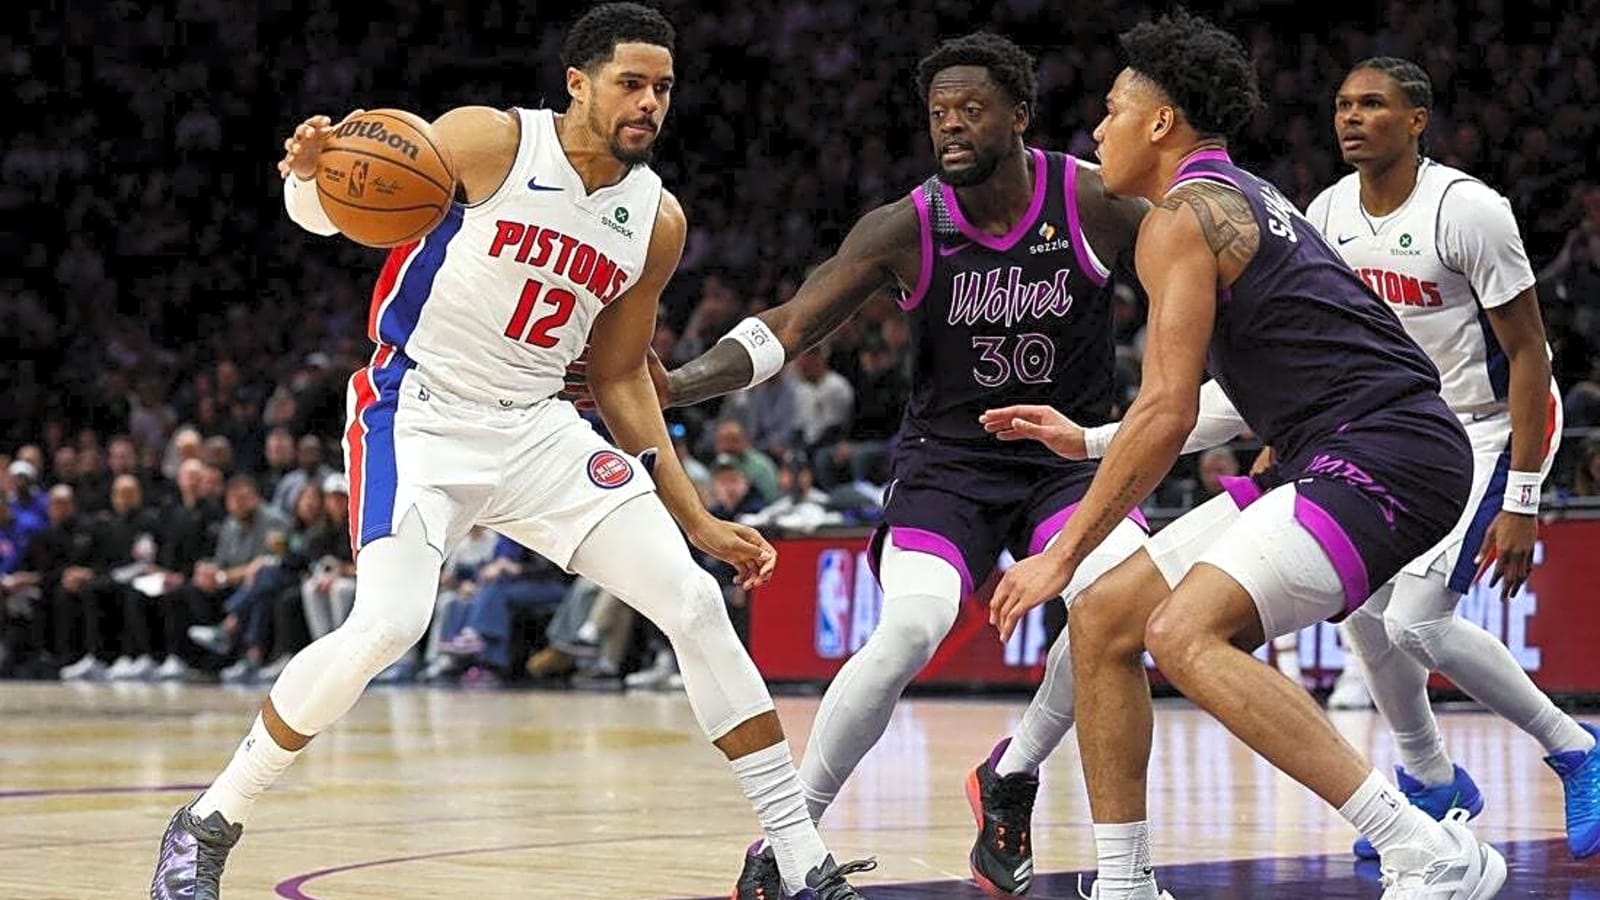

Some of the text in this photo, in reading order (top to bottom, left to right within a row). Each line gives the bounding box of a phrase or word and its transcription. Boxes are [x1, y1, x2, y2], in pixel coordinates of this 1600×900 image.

[335, 120, 419, 161] Wilson
[488, 220, 629, 305] PISTONS
[1029, 239, 1070, 255] sezzle
[504, 278, 577, 349] 12
[948, 266, 1073, 328] Wolves
[1353, 267, 1444, 307] STONS
[972, 333, 1056, 388] 30
